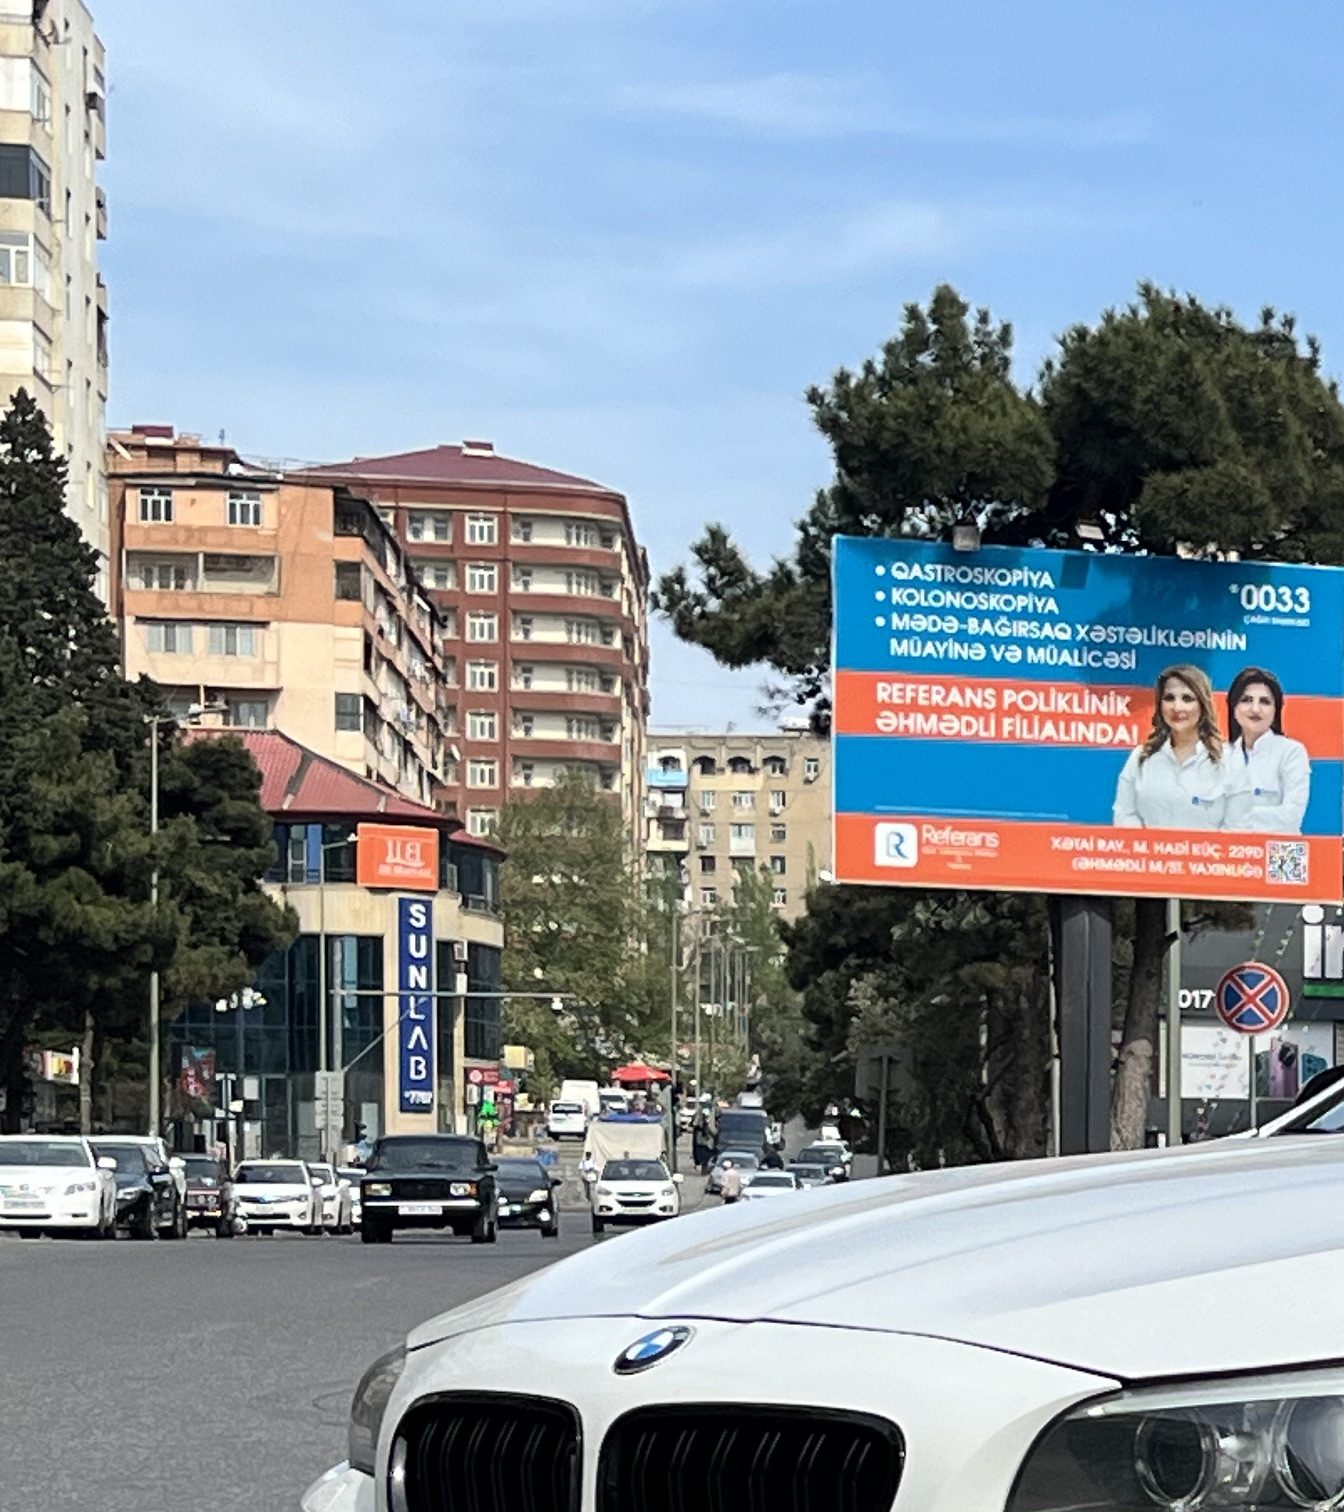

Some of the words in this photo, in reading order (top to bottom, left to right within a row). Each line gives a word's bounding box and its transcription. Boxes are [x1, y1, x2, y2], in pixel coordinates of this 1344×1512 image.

[890, 562, 1055, 589] QASTROSKOPİYA
[891, 587, 1059, 614] KOLONOSKOPİYA
[891, 612, 1073, 640] MƏDƏ-BAĞIRSAQ
[890, 637, 986, 661] MÜAYİNƏ
[990, 644, 1022, 663] VƏ
[1026, 645, 1137, 670] MÜALİCƏSİ
[876, 682, 997, 709] REFERANS
[1002, 687, 1132, 717] POLİKLİNİK
[875, 710, 996, 738] ƏHMƏDLİ
[1002, 713, 1138, 746] FİLİALINDA!
[921, 823, 1000, 848] Referans
